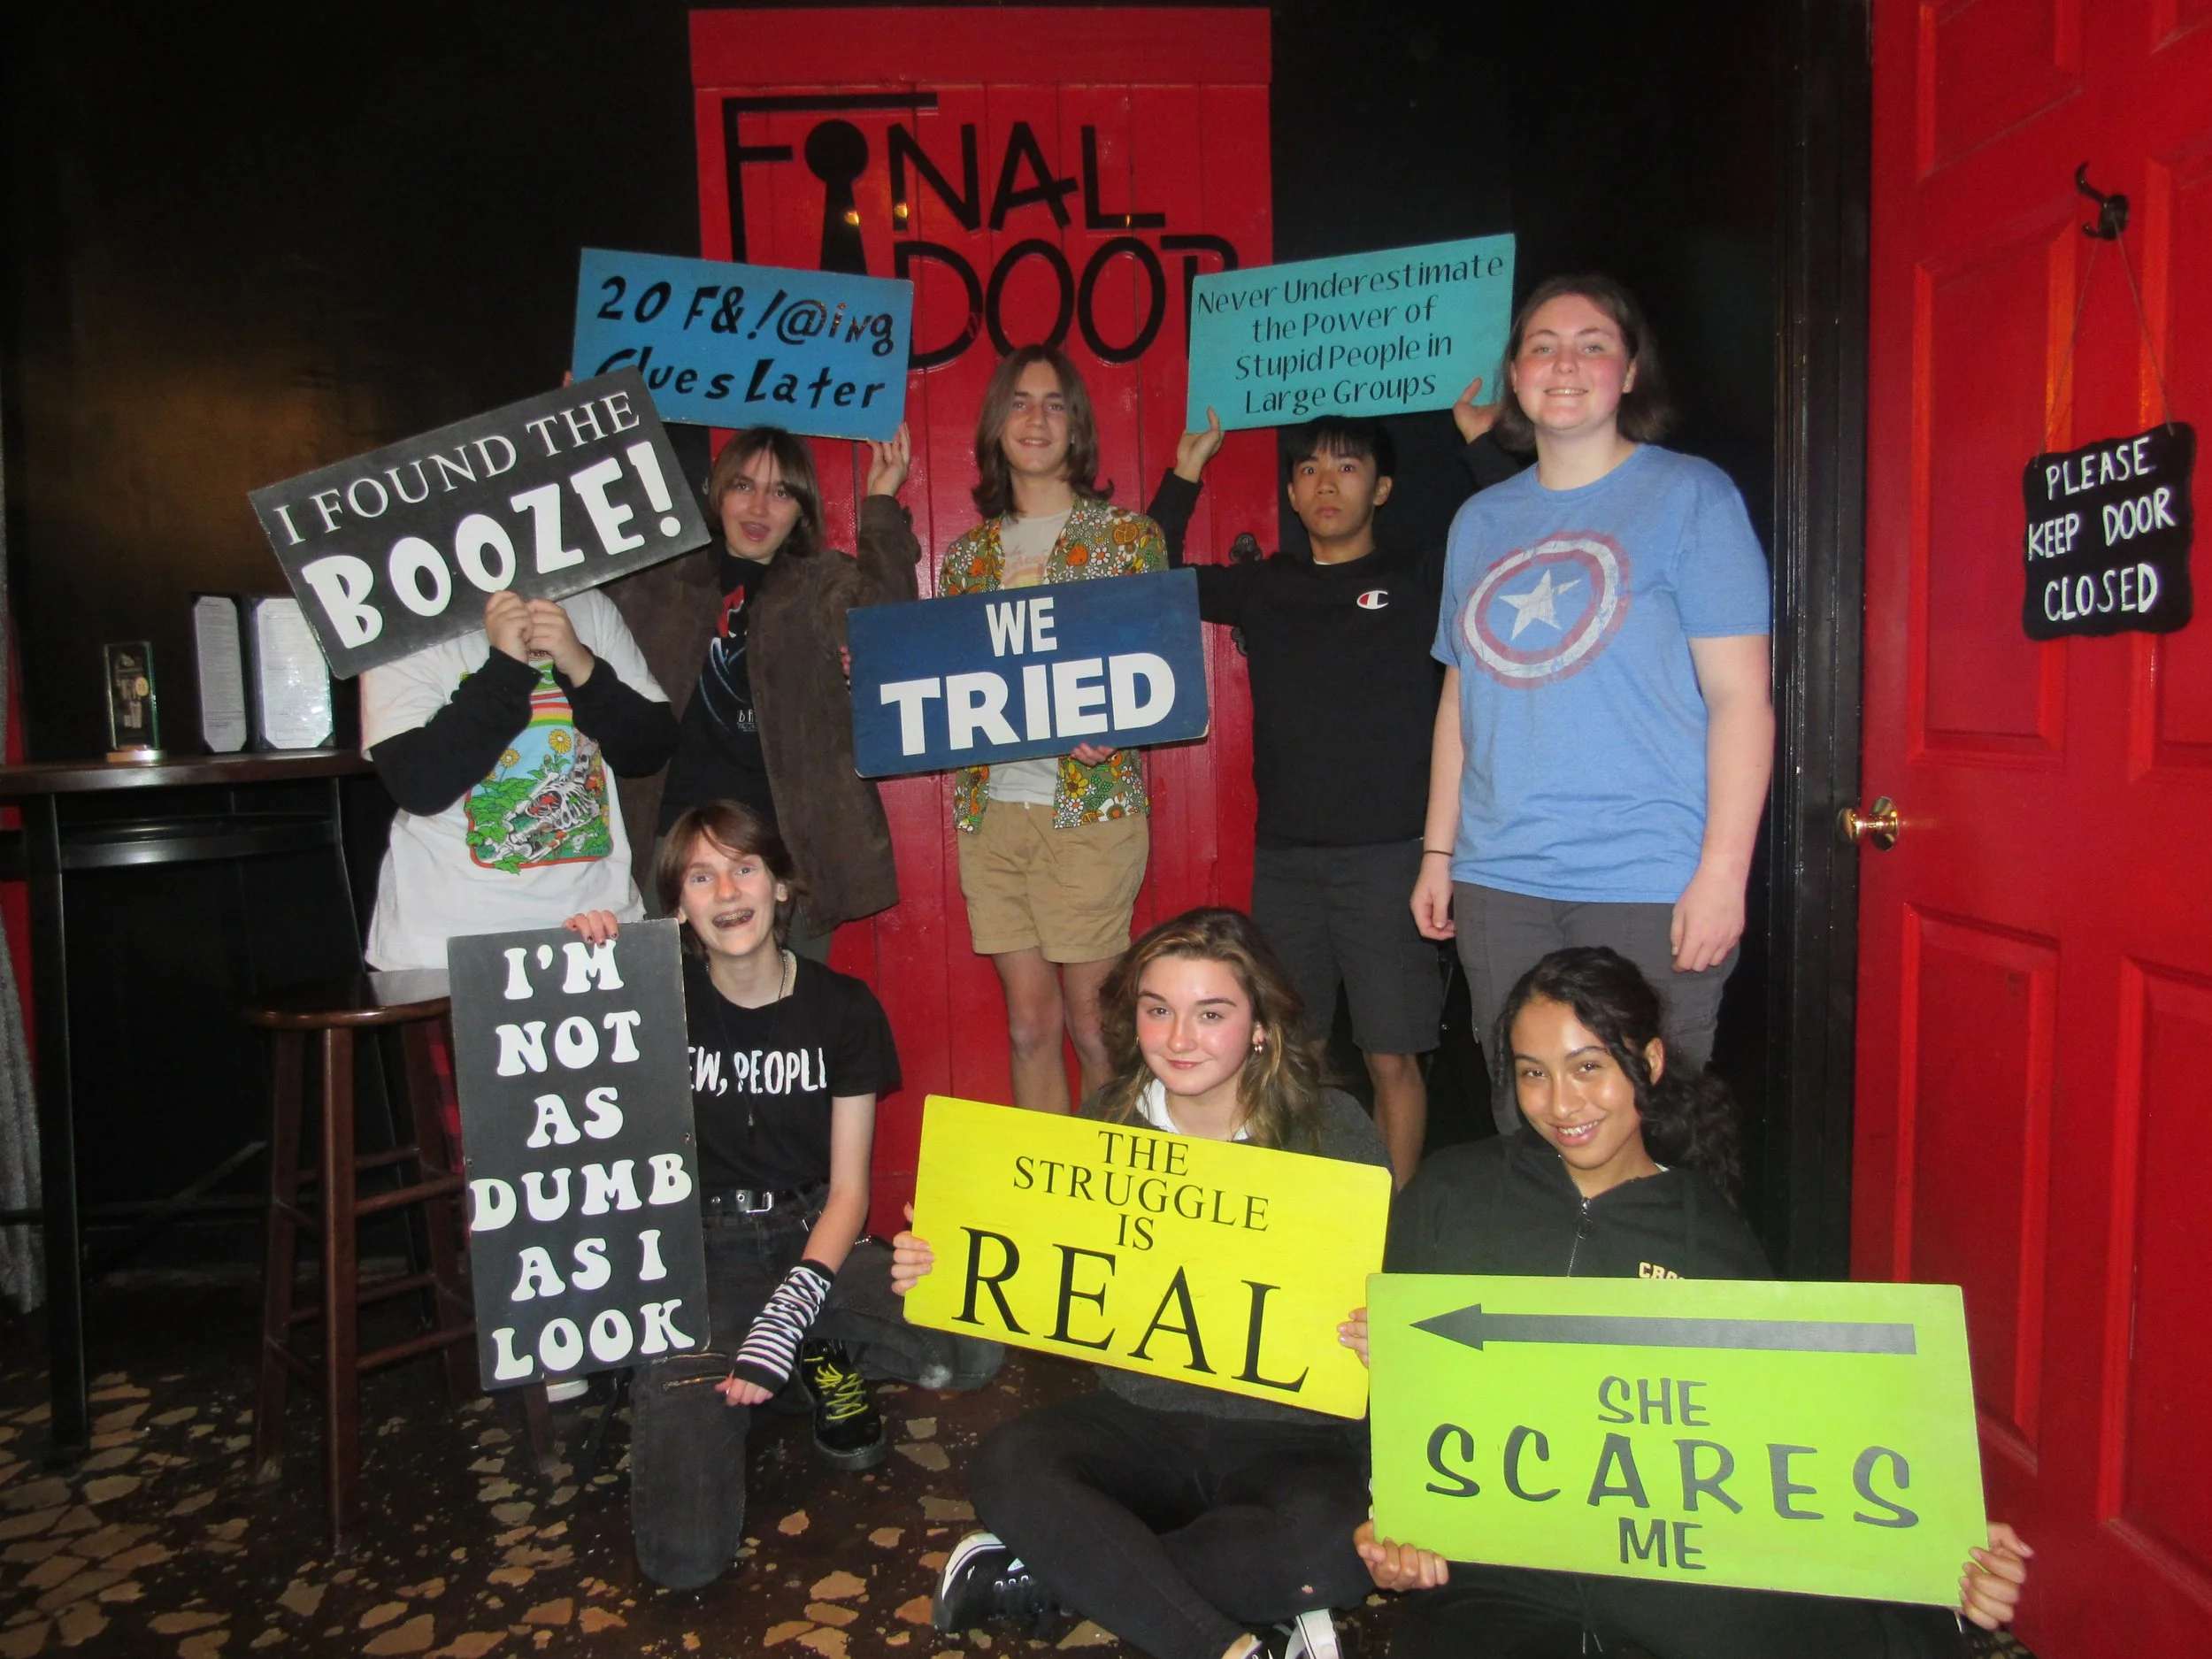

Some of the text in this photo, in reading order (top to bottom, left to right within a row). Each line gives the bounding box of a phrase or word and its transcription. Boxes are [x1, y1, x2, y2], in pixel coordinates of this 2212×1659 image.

[722, 92, 1165, 277] FINAL
[596, 276, 672, 323] 20
[1197, 254, 1503, 316] Never Underestimate
[1253, 294, 1439, 342] the Power of
[744, 358, 886, 409] Later
[1235, 333, 1452, 380] Stupid People in
[1246, 373, 1436, 415] Large Groups
[273, 391, 641, 545] I FOUND THE
[2045, 436, 2157, 500] PLEASE
[301, 441, 682, 649] BOOZE!
[2027, 487, 2177, 561] KEEP DOOR
[2044, 562, 2159, 621] CLOSED
[986, 596, 1058, 657] WE
[879, 651, 1176, 757] TRIED
[503, 939, 625, 1000] I'M
[495, 1010, 641, 1077] NOT
[687, 1046, 728, 1097] W,
[526, 1087, 625, 1148] AS
[1097, 1130, 1190, 1177] THE
[469, 1153, 693, 1233] DUMB
[1012, 1156, 1270, 1233] STRUGGLE
[1115, 1213, 1155, 1251] IS
[511, 1229, 667, 1302] AS I
[491, 1298, 695, 1381] LOOK
[951, 1225, 1310, 1394] REAL
[1598, 1375, 1710, 1426] SHE
[1425, 1422, 1919, 1529] SCARES
[1617, 1517, 1707, 1570] ME
